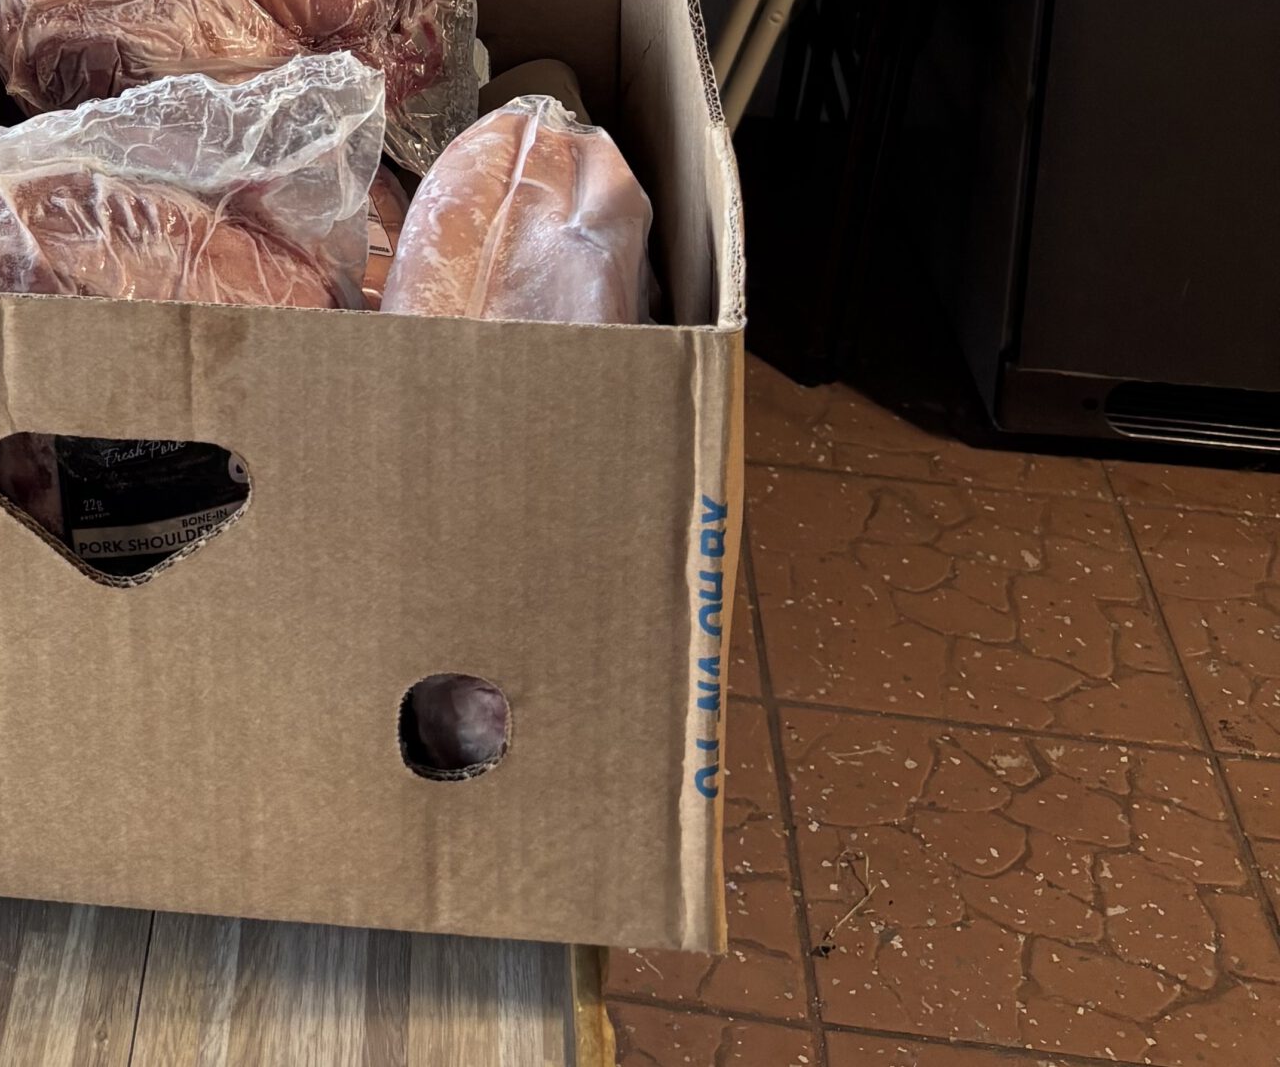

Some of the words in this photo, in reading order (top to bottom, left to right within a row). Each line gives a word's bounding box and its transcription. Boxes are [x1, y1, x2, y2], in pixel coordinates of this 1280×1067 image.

[102, 444, 146, 469] Fresh
[147, 440, 187, 461] Pork
[82, 499, 105, 513] 22g
[182, 508, 229, 529] BONE-IN
[79, 537, 125, 555] PORK
